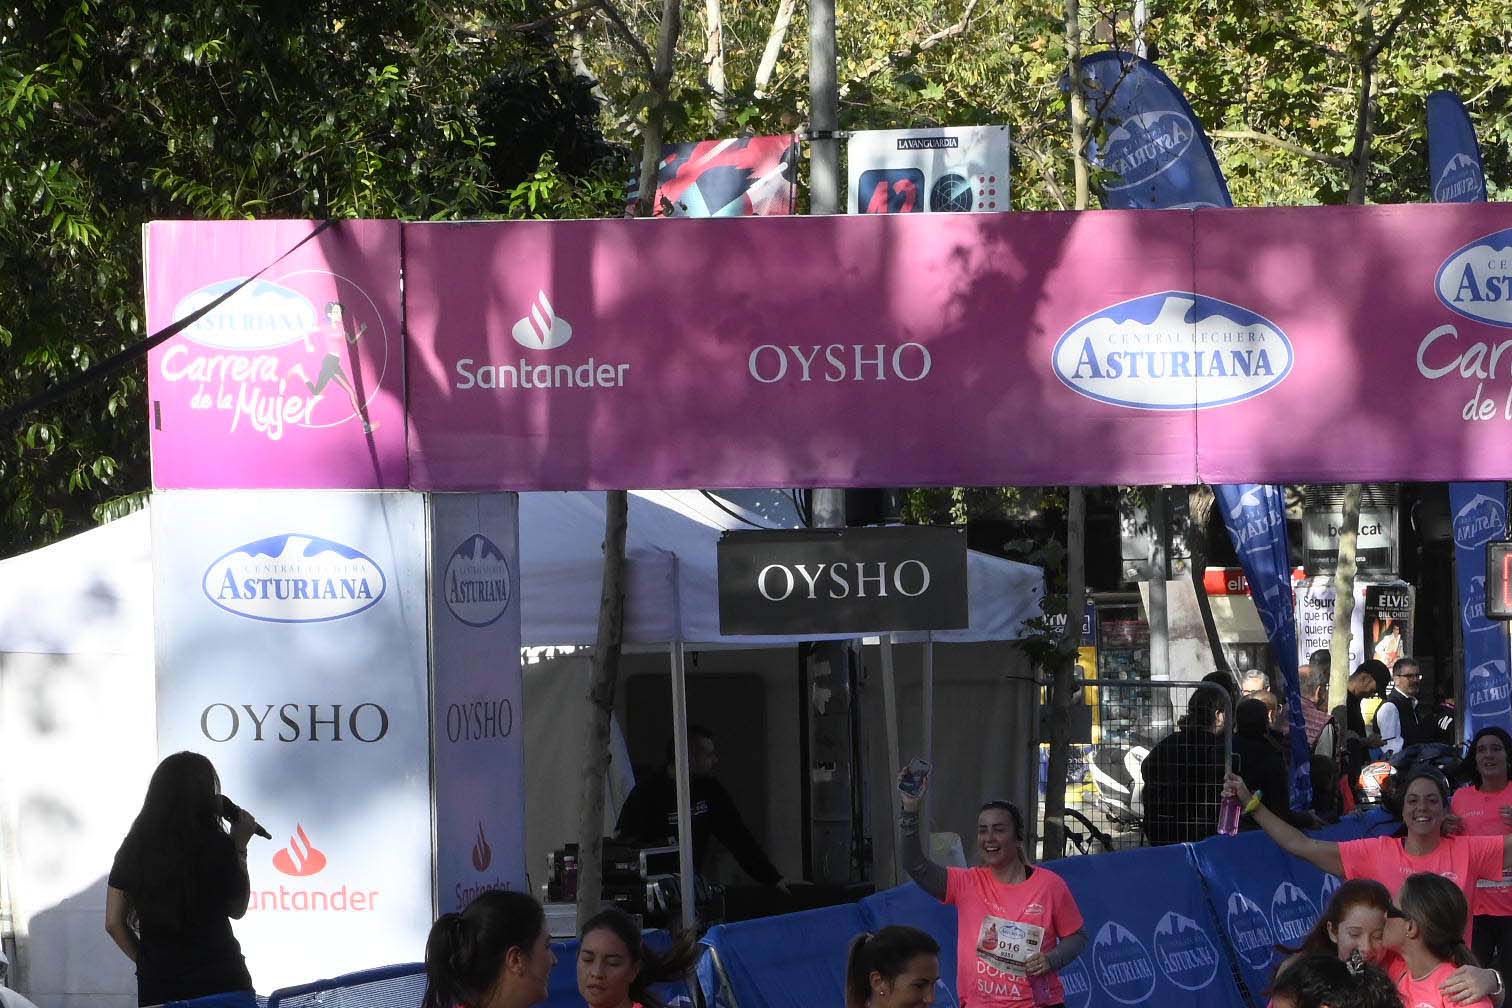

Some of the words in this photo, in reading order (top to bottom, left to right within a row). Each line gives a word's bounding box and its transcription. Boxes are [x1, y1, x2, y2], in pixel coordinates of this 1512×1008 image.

[1108, 332, 1184, 345] CENTRAL
[1192, 331, 1267, 344] LECHERA
[161, 344, 281, 382] Carrera
[456, 357, 631, 389] Santander
[748, 343, 933, 384] OYSHO
[1071, 336, 1276, 379] ASTURIANA
[230, 379, 324, 440] Mujer
[1462, 383, 1497, 421] de
[217, 568, 373, 600] ASTURIANA
[449, 568, 507, 605] ASTURIANA
[757, 559, 931, 602] OYSHO
[1379, 595, 1409, 607] ELVIS
[200, 703, 389, 743] OYSHO
[446, 698, 513, 743] OYSHO
[247, 885, 379, 912] antander
[1000, 942, 1020, 951] 016
[977, 979, 1021, 997] SUMA
